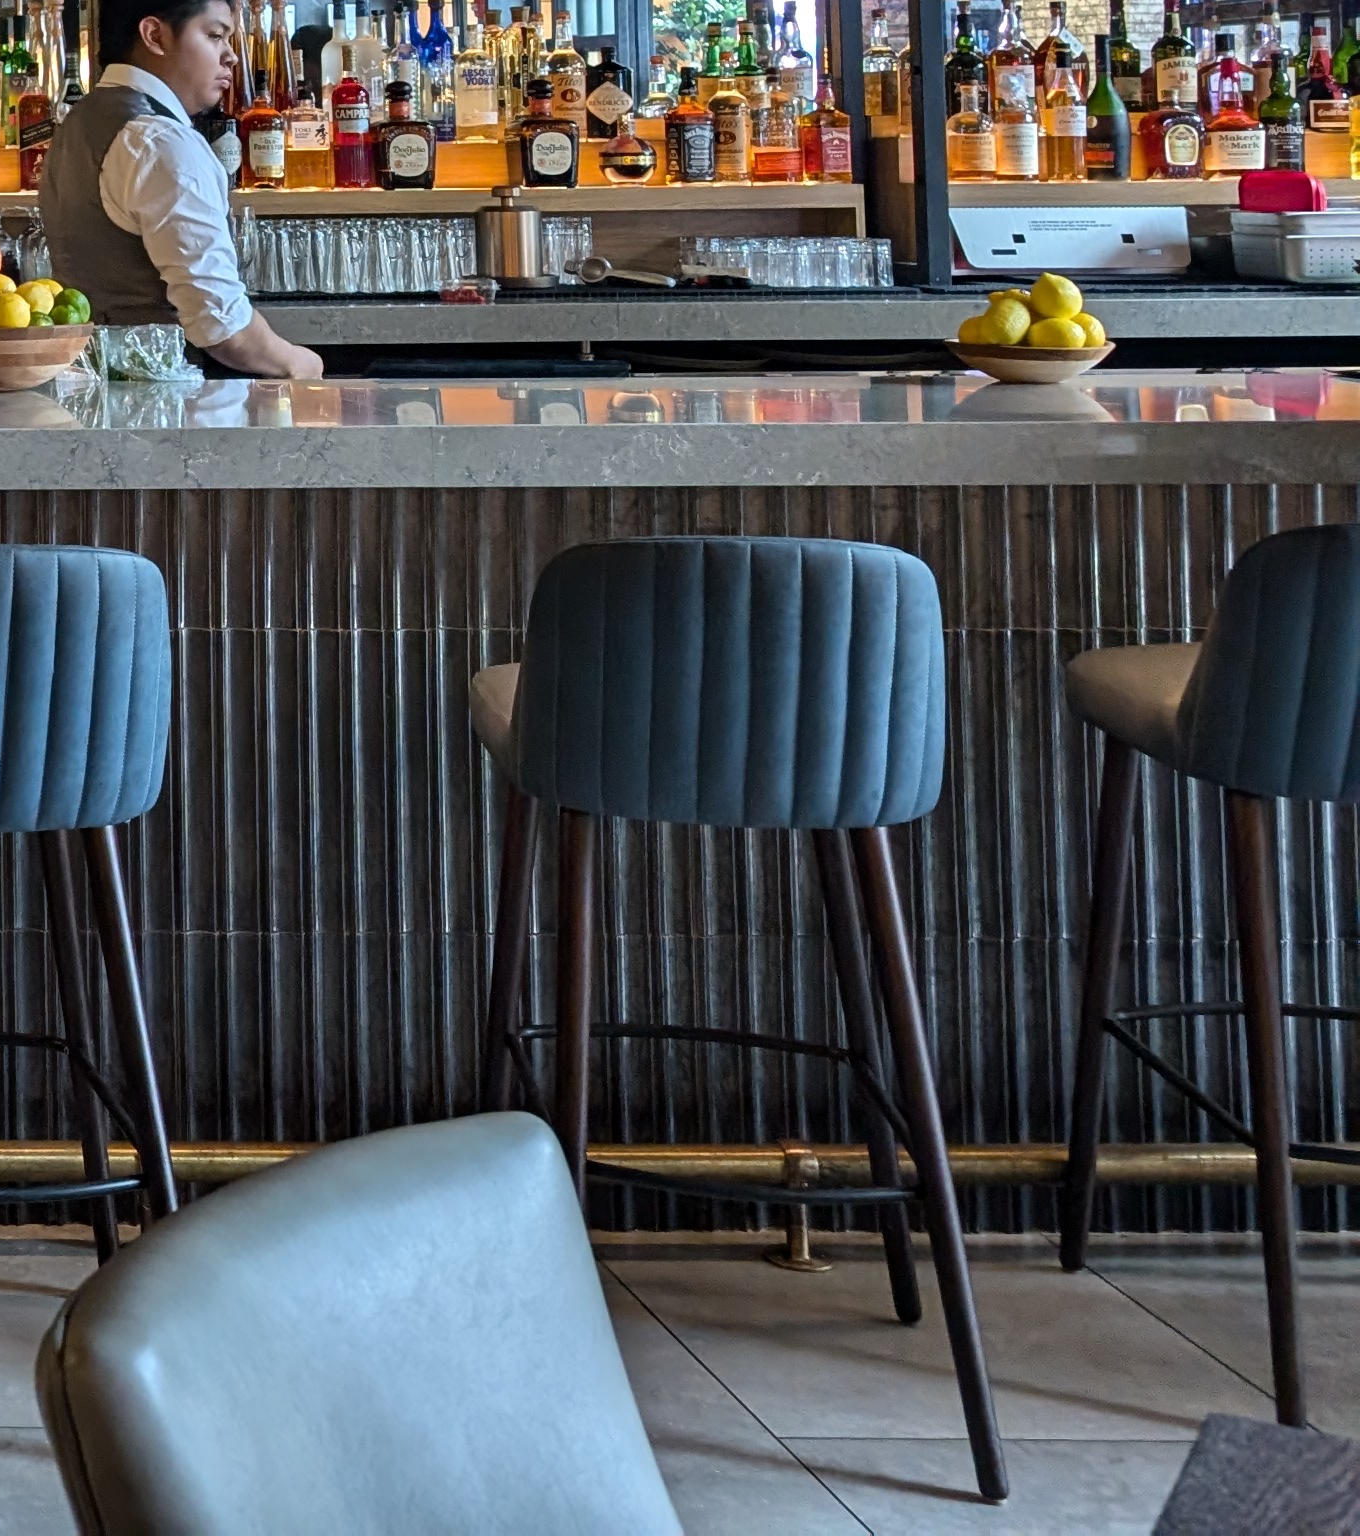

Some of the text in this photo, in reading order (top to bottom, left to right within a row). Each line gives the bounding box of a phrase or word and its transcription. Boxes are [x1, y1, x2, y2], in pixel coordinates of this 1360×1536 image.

[465, 77, 494, 86] VODKA
[1218, 134, 1261, 142] Maker's
[1231, 141, 1261, 149] Mark
[393, 144, 426, 155] Don Julio
